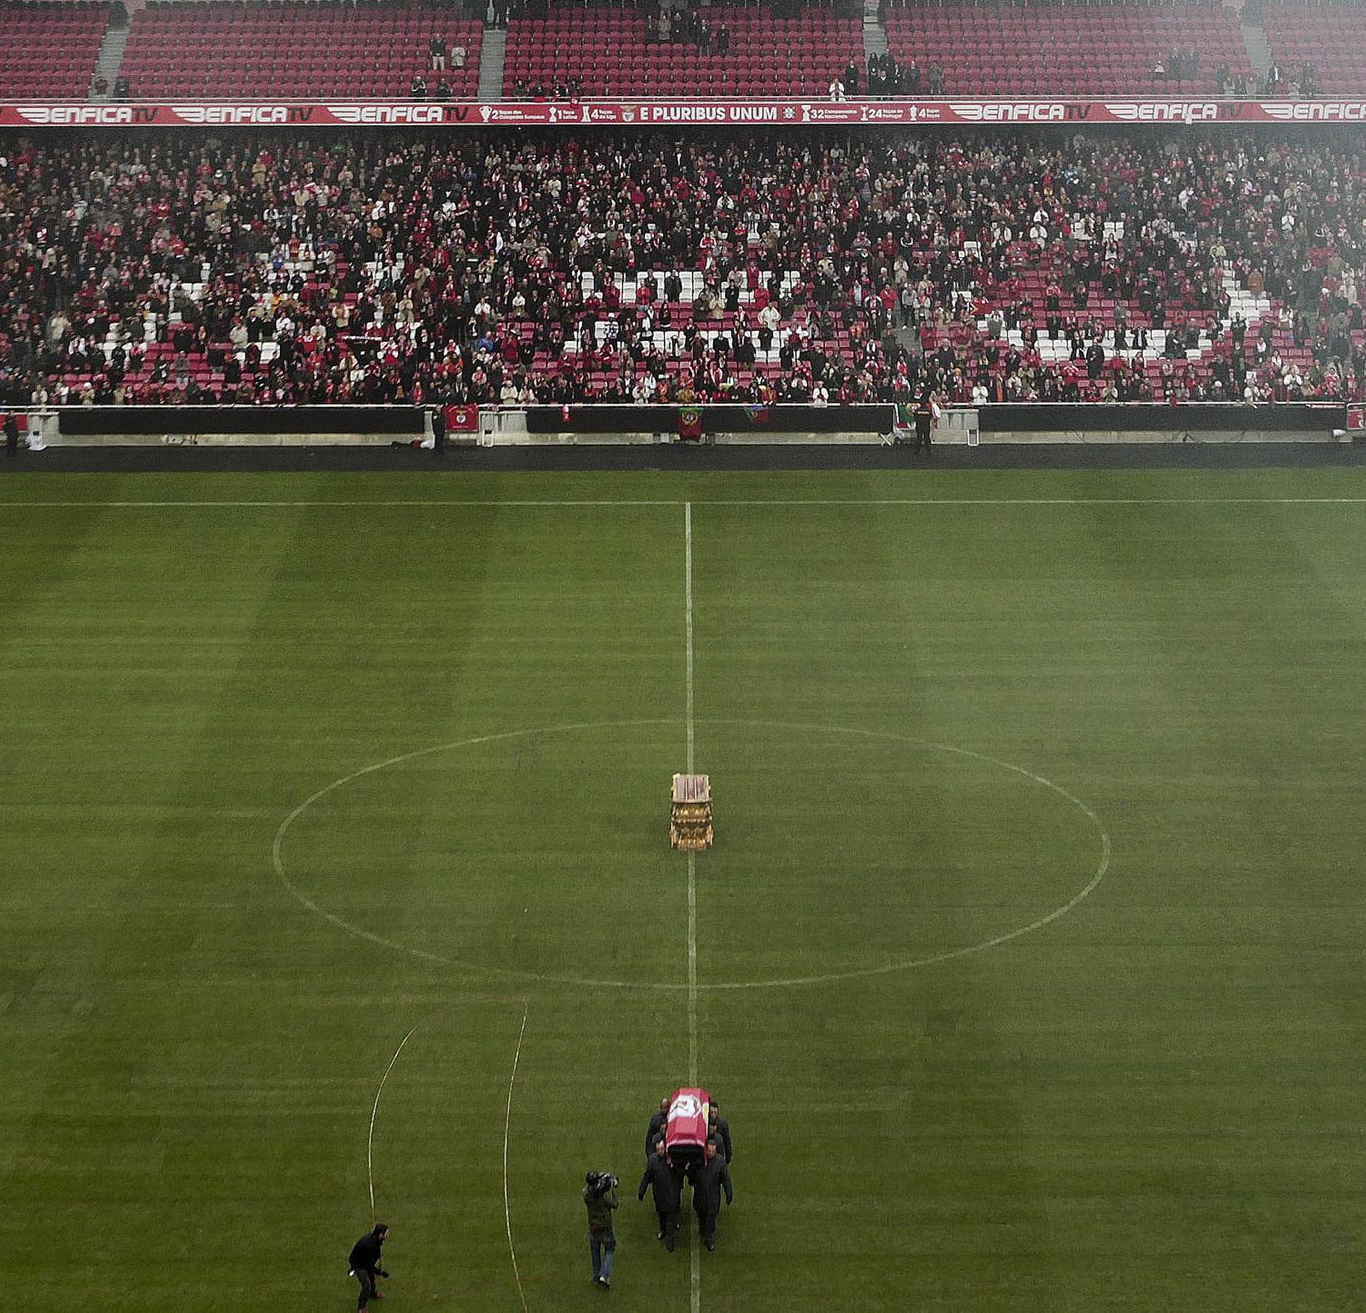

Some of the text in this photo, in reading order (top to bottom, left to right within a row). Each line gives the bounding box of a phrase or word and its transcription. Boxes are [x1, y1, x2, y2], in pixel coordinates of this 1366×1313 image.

[16, 107, 133, 123] BENFICA
[171, 106, 288, 123] BENFICA
[326, 106, 443, 122] BENFICA
[640, 107, 777, 120] E PLURIBUS UNUM
[810, 110, 825, 119] 32
[868, 109, 883, 119] 24
[950, 104, 1066, 120] BENFICA
